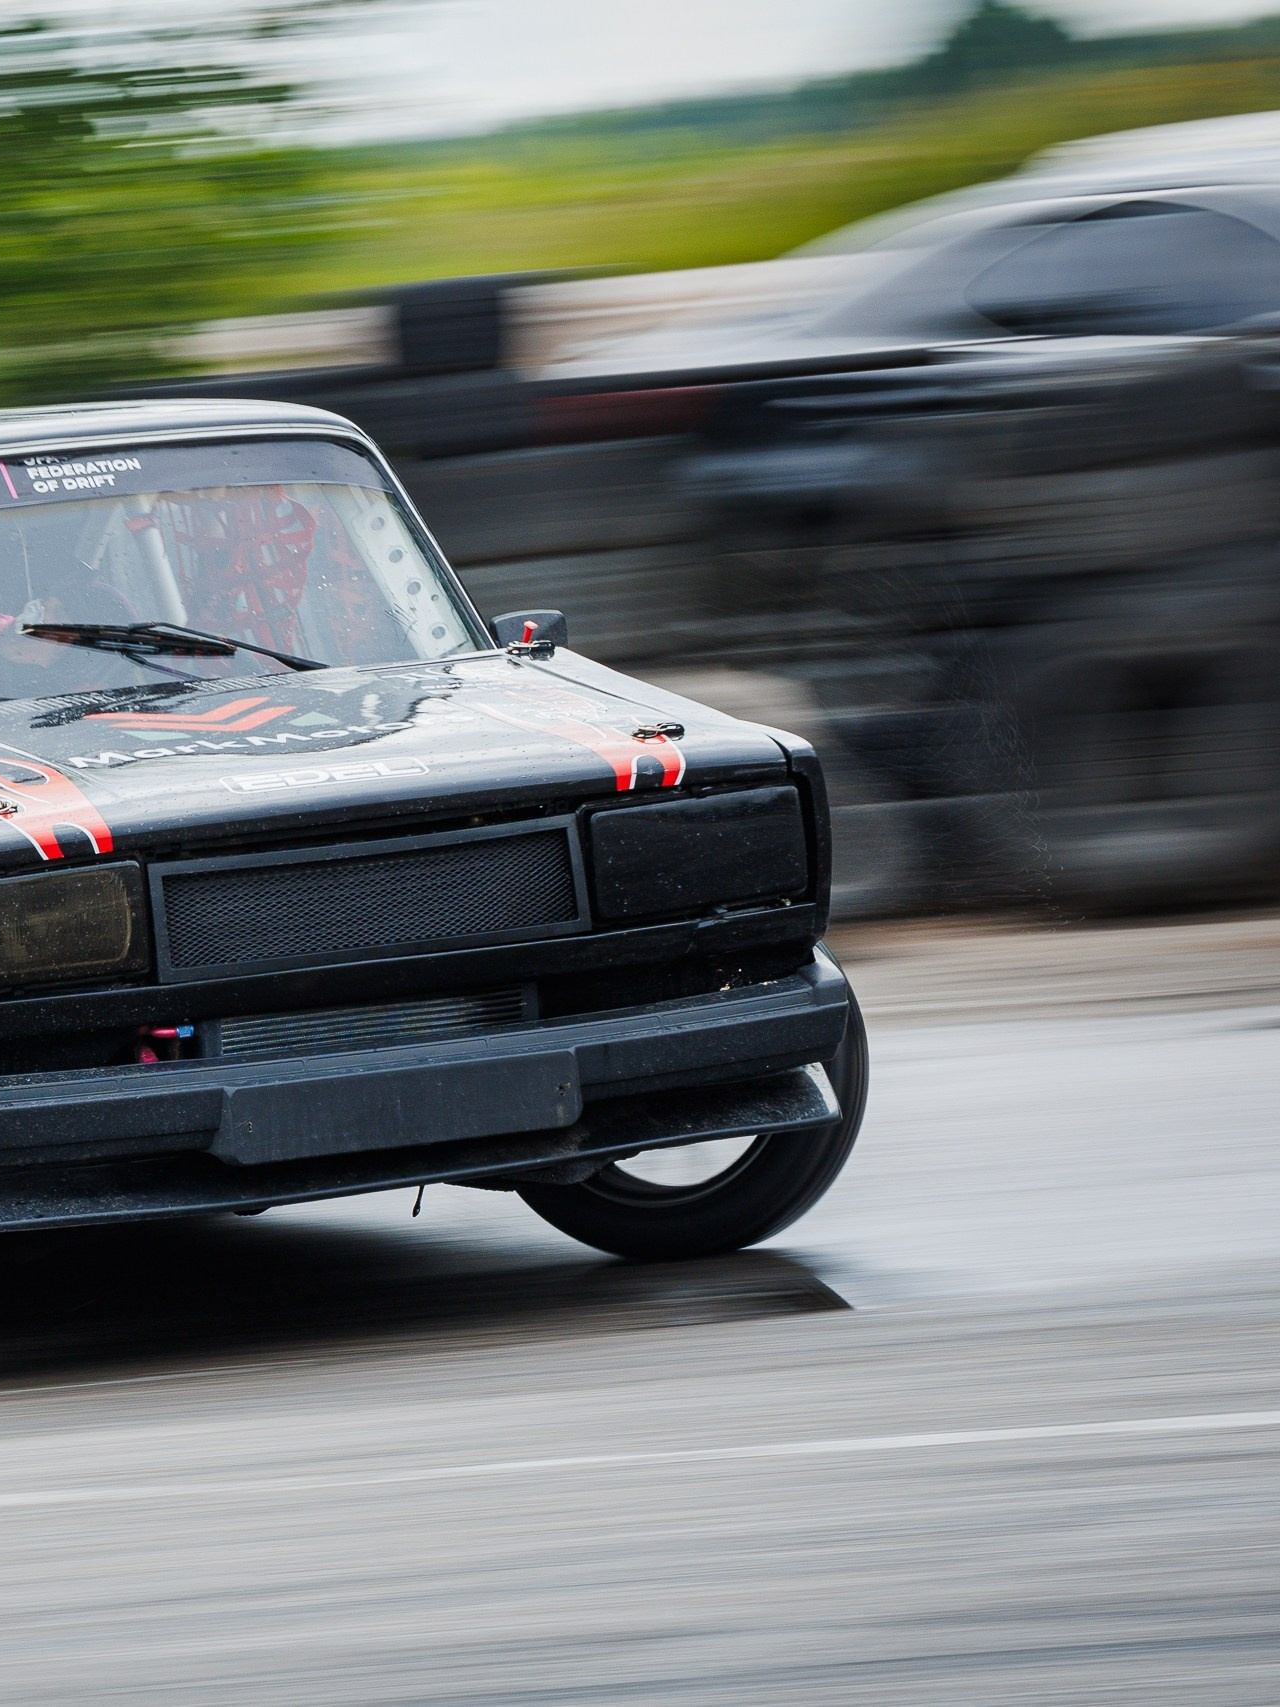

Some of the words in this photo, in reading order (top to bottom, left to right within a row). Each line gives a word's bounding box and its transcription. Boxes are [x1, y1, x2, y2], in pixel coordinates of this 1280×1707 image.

[25, 457, 142, 480] FEDERATION
[32, 479, 60, 494] OF
[61, 473, 116, 492] DRIFT
[232, 761, 423, 791] EDEL
